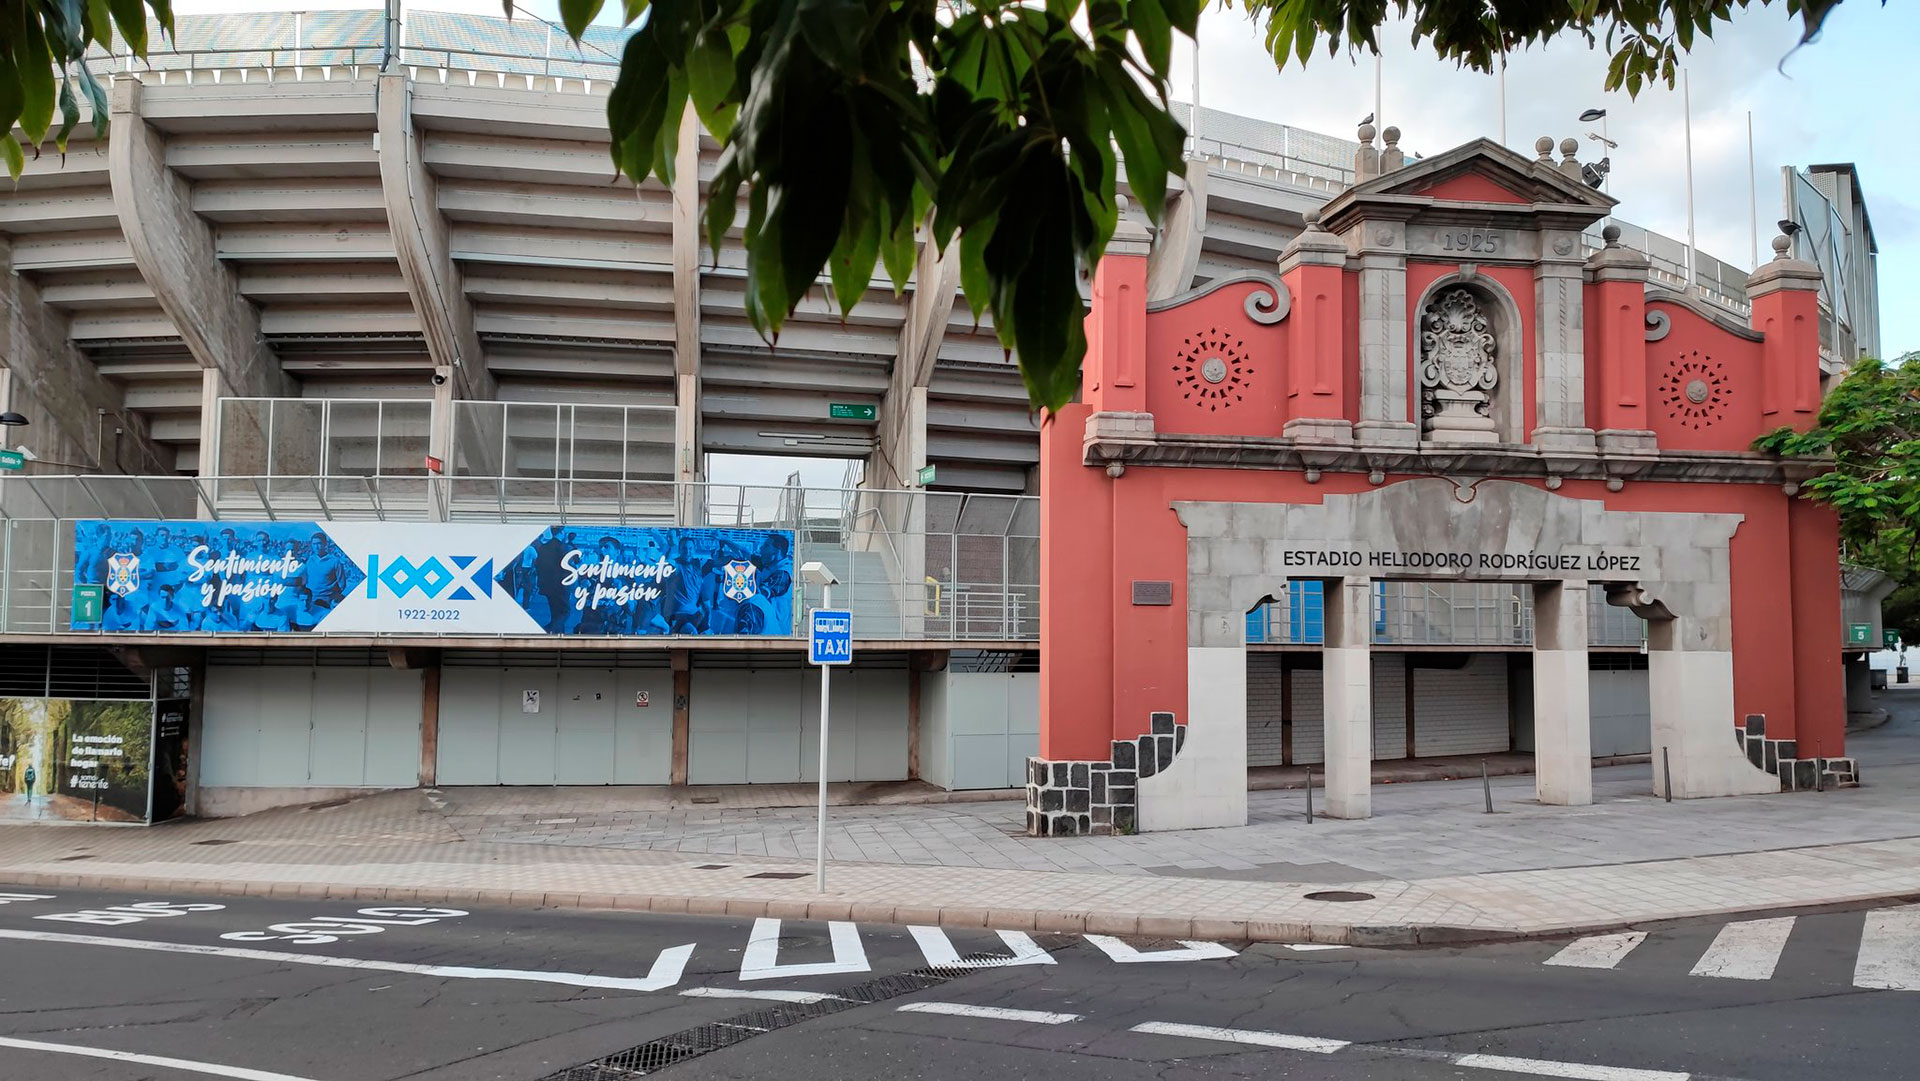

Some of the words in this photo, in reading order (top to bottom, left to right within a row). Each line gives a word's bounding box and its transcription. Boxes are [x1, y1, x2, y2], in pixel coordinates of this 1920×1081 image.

[1443, 233, 1500, 253] 1925
[187, 544, 303, 582] Sentimiento
[560, 549, 677, 586] Sentimiento
[1284, 551, 1362, 567] ESTADIO
[1369, 551, 1473, 568] HELIODORO
[1479, 550, 1582, 570] RODRÍGUEZ
[1587, 551, 1641, 571] LÓPEZ
[200, 582, 216, 607] y
[217, 578, 287, 607] pasión
[574, 585, 590, 611] y
[591, 582, 662, 611] pasión
[84, 600, 92, 617] 1
[398, 609, 460, 621] 1922-2022
[1858, 631, 1865, 640] 5
[815, 639, 849, 656] TAXI
[72, 733, 84, 743] La
[84, 734, 123, 744] emoción
[33, 901, 226, 925] BUS
[220, 907, 469, 944] SOLO
